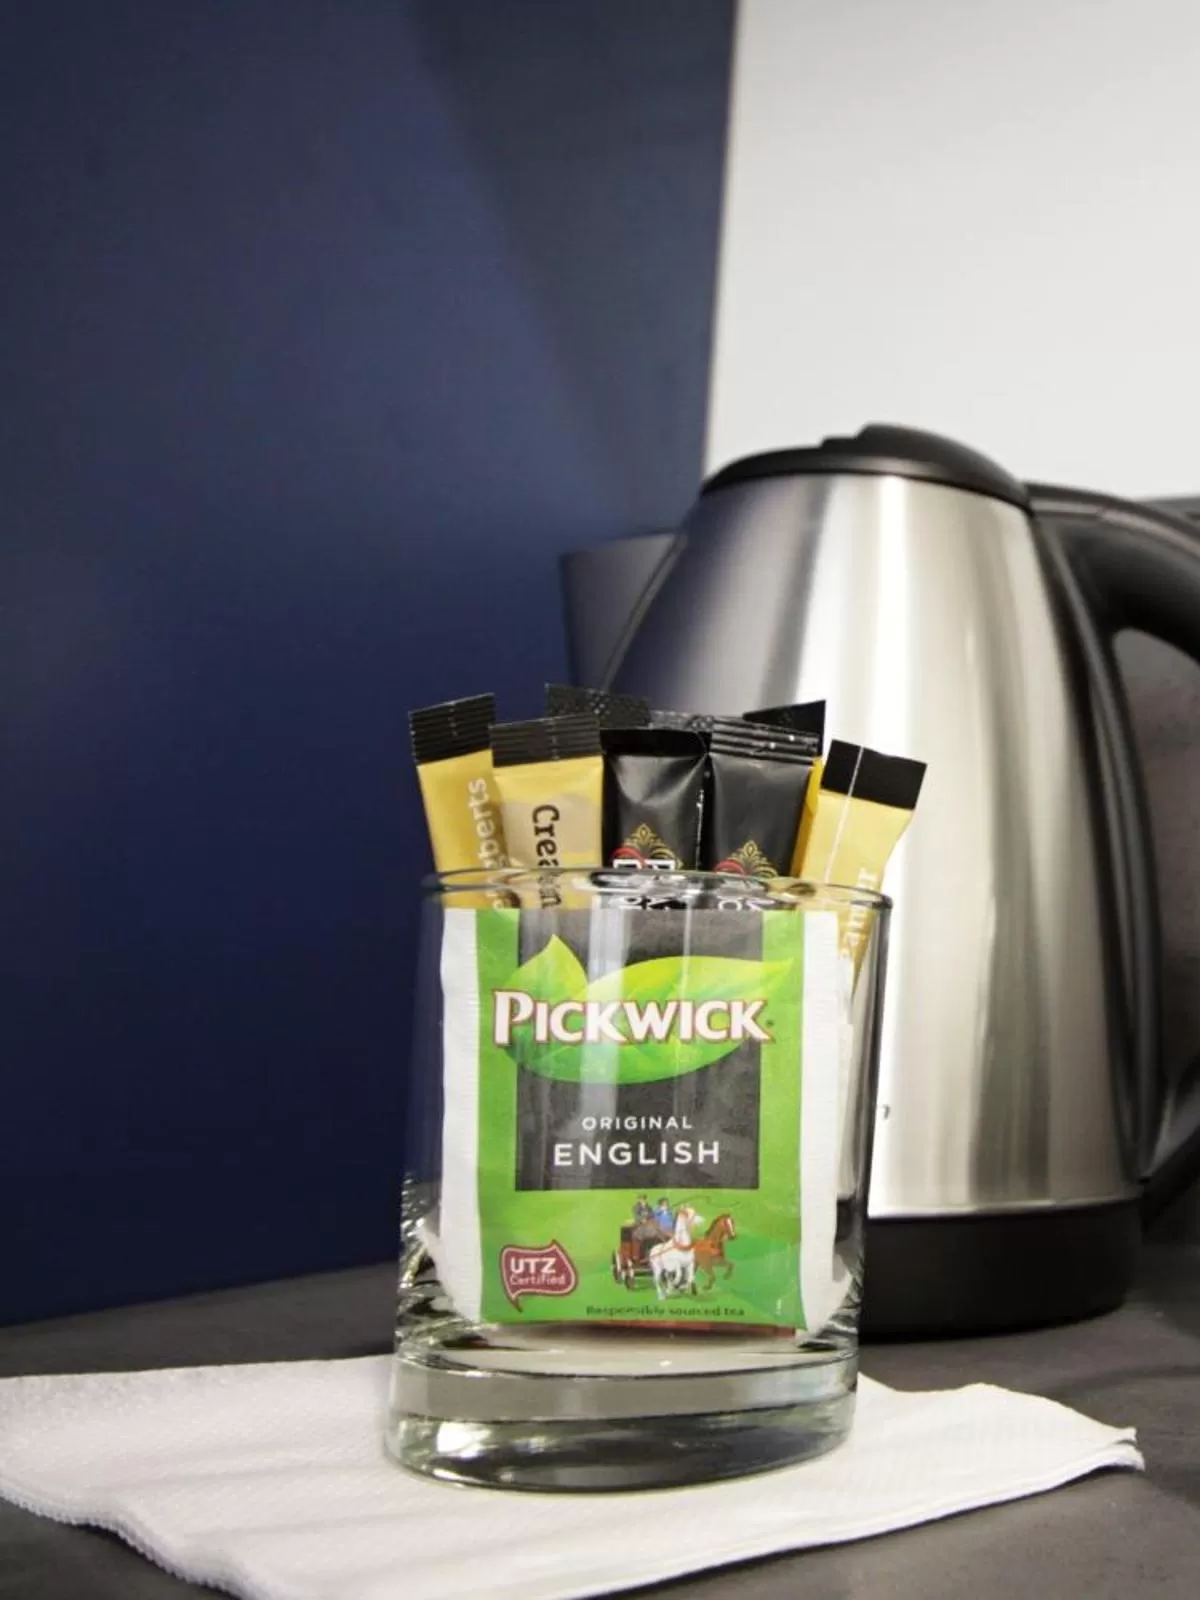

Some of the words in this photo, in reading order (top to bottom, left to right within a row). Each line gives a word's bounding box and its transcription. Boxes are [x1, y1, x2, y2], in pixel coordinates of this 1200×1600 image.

[492, 988, 773, 1046] PICKWICK
[581, 1115, 693, 1132] ORIGINAL
[553, 1140, 720, 1167] ENGLISH
[510, 1256, 557, 1274] UTZ
[510, 1273, 566, 1287] Certified
